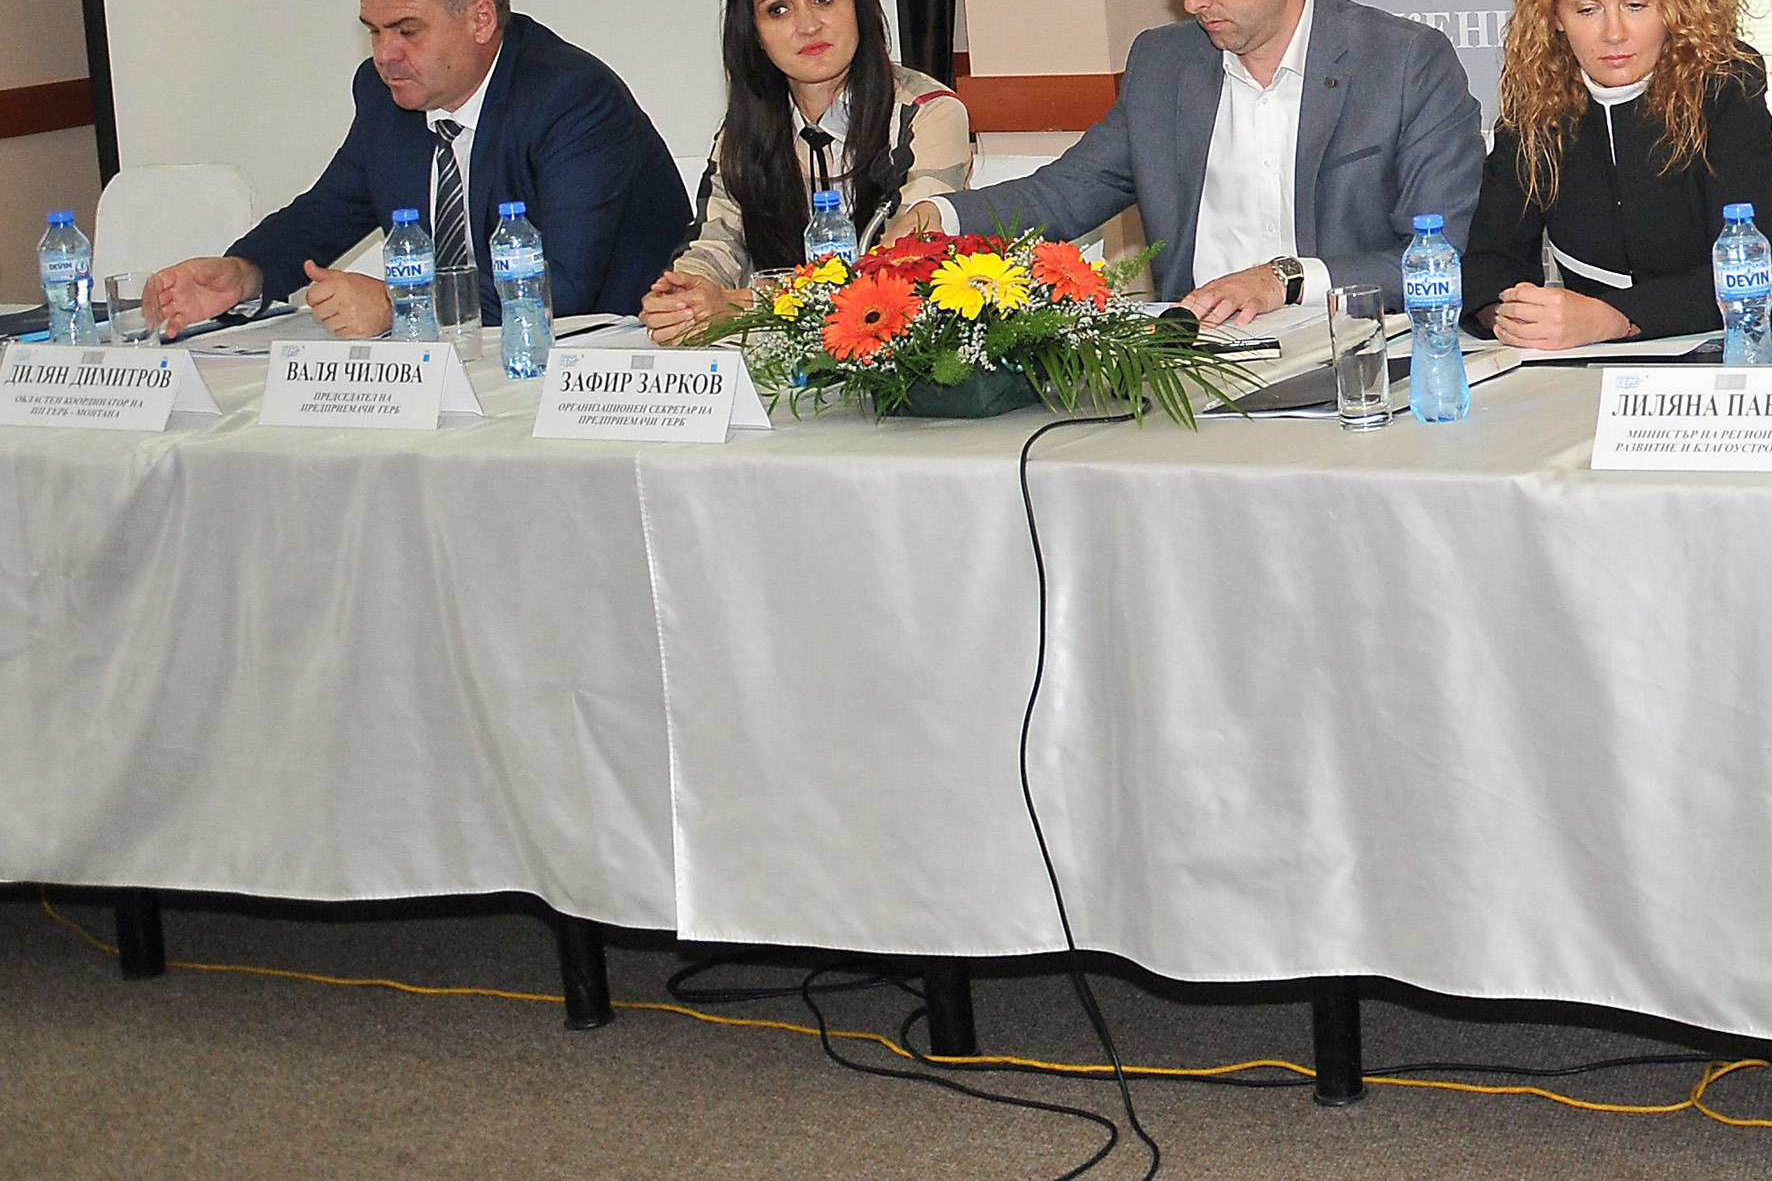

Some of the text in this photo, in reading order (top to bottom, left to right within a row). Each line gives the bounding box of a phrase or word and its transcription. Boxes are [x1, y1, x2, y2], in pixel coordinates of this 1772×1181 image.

[386, 264, 422, 277] DEVIN
[1726, 270, 1769, 288] DEVIN
[1407, 281, 1450, 296] DEVIN
[4, 364, 173, 388] ДИЛЯН ДИМИТРОВ
[286, 361, 423, 384] ВАЛЯ ЧИЛОВА
[560, 371, 723, 395] ЗАФИР ЗАРКОВ
[15, 395, 144, 408] ОБЛАСТЕН КООРДИНАТОР НА
[313, 392, 392, 402] ПРЕДСЕДАТЕЛ НА
[300, 403, 401, 415] ПРЕДПРИЕМАЧИ ГЕРБ
[558, 402, 713, 415] ОРГАНИЗАЦИОНЕН СЕКРЕТАР НА
[1612, 393, 1719, 417] ЛИЛЯНА
[48, 407, 70, 417] ГЕРБ
[76, 409, 120, 419] МОНТАНА
[578, 414, 687, 427] ПРЕДПРИЕМАЧИ ГЕРБ
[1626, 430, 1698, 440] МИНИСТЪР
[1700, 430, 1718, 440] НА
[1615, 442, 1677, 453] РАЗВИТИЕ
[1680, 443, 1690, 453] И
